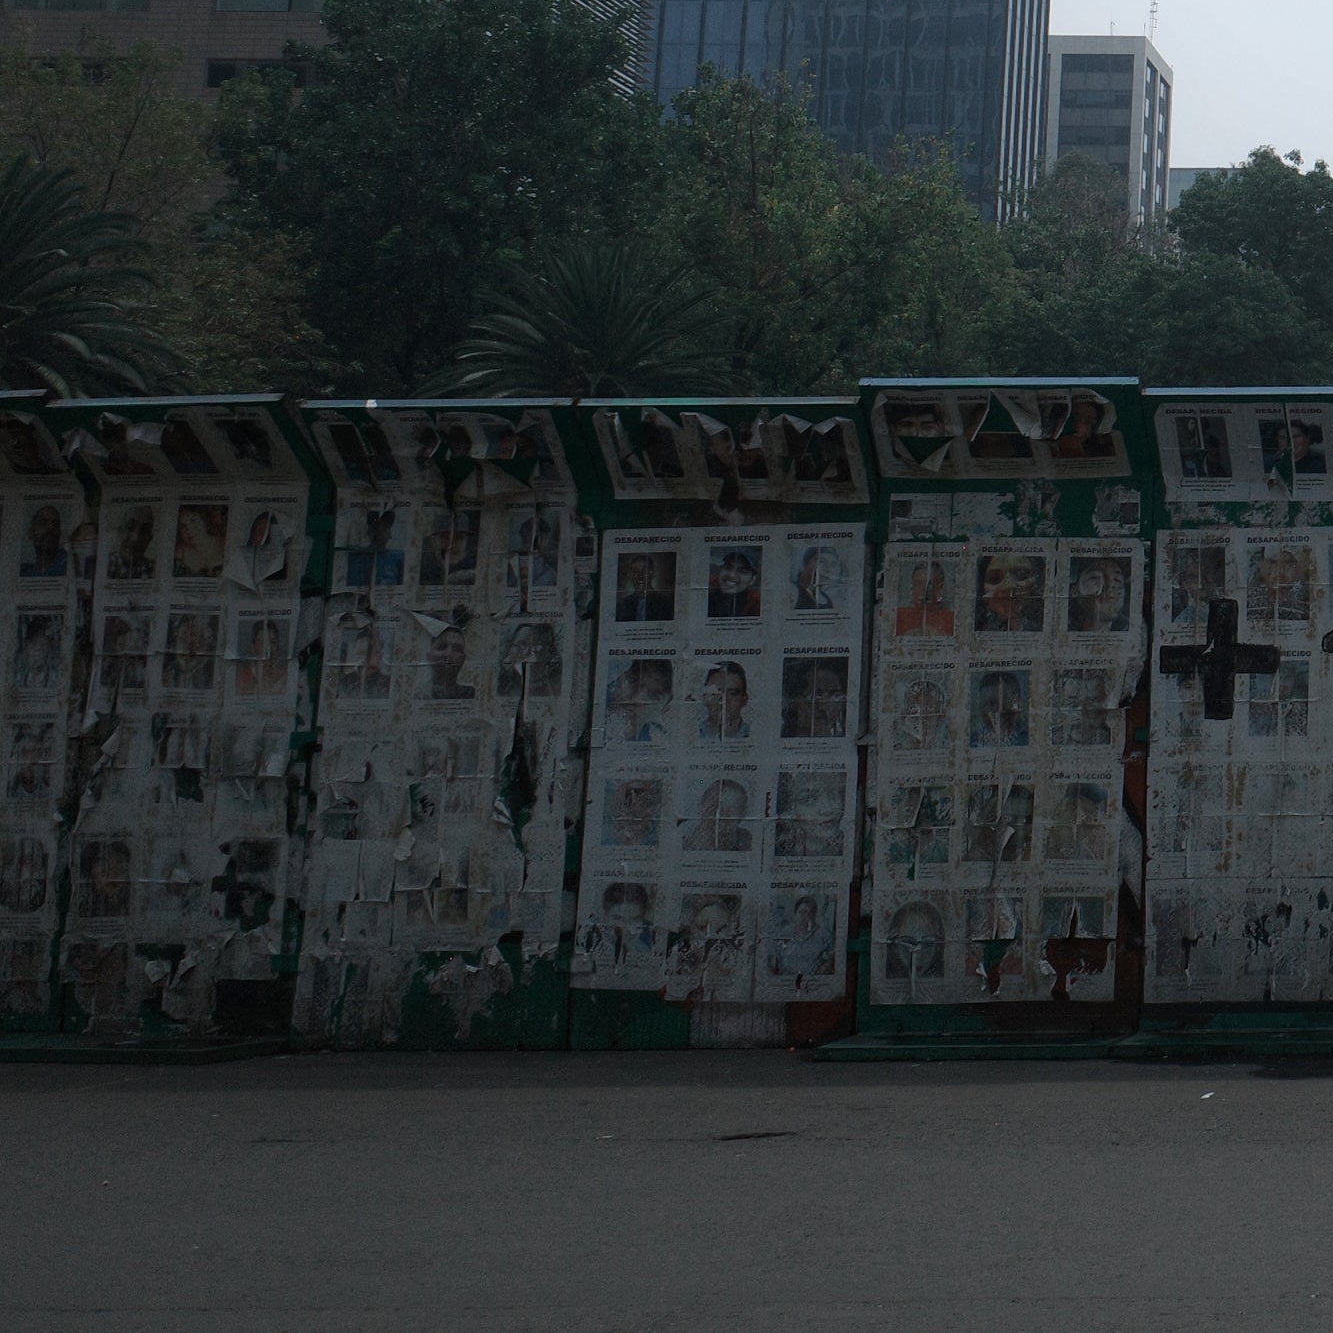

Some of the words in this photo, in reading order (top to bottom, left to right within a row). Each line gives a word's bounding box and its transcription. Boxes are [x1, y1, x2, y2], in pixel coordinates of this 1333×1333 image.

[1165, 407, 1233, 415] DESAPRECIDA
[1255, 407, 1323, 415] DESARECIDO
[614, 535, 682, 544] DESAPARECIDO
[704, 534, 770, 543] DESAPARECIDO
[1168, 536, 1231, 545] DESAPRECIDO
[896, 550, 961, 559] DESAPAECIDO
[608, 648, 677, 657] DESAPARECIDO
[694, 648, 762, 656] DESAPARECIDO
[783, 646, 851, 655] DESAPARECIDA
[968, 659, 1033, 668] DESAPARECIDO
